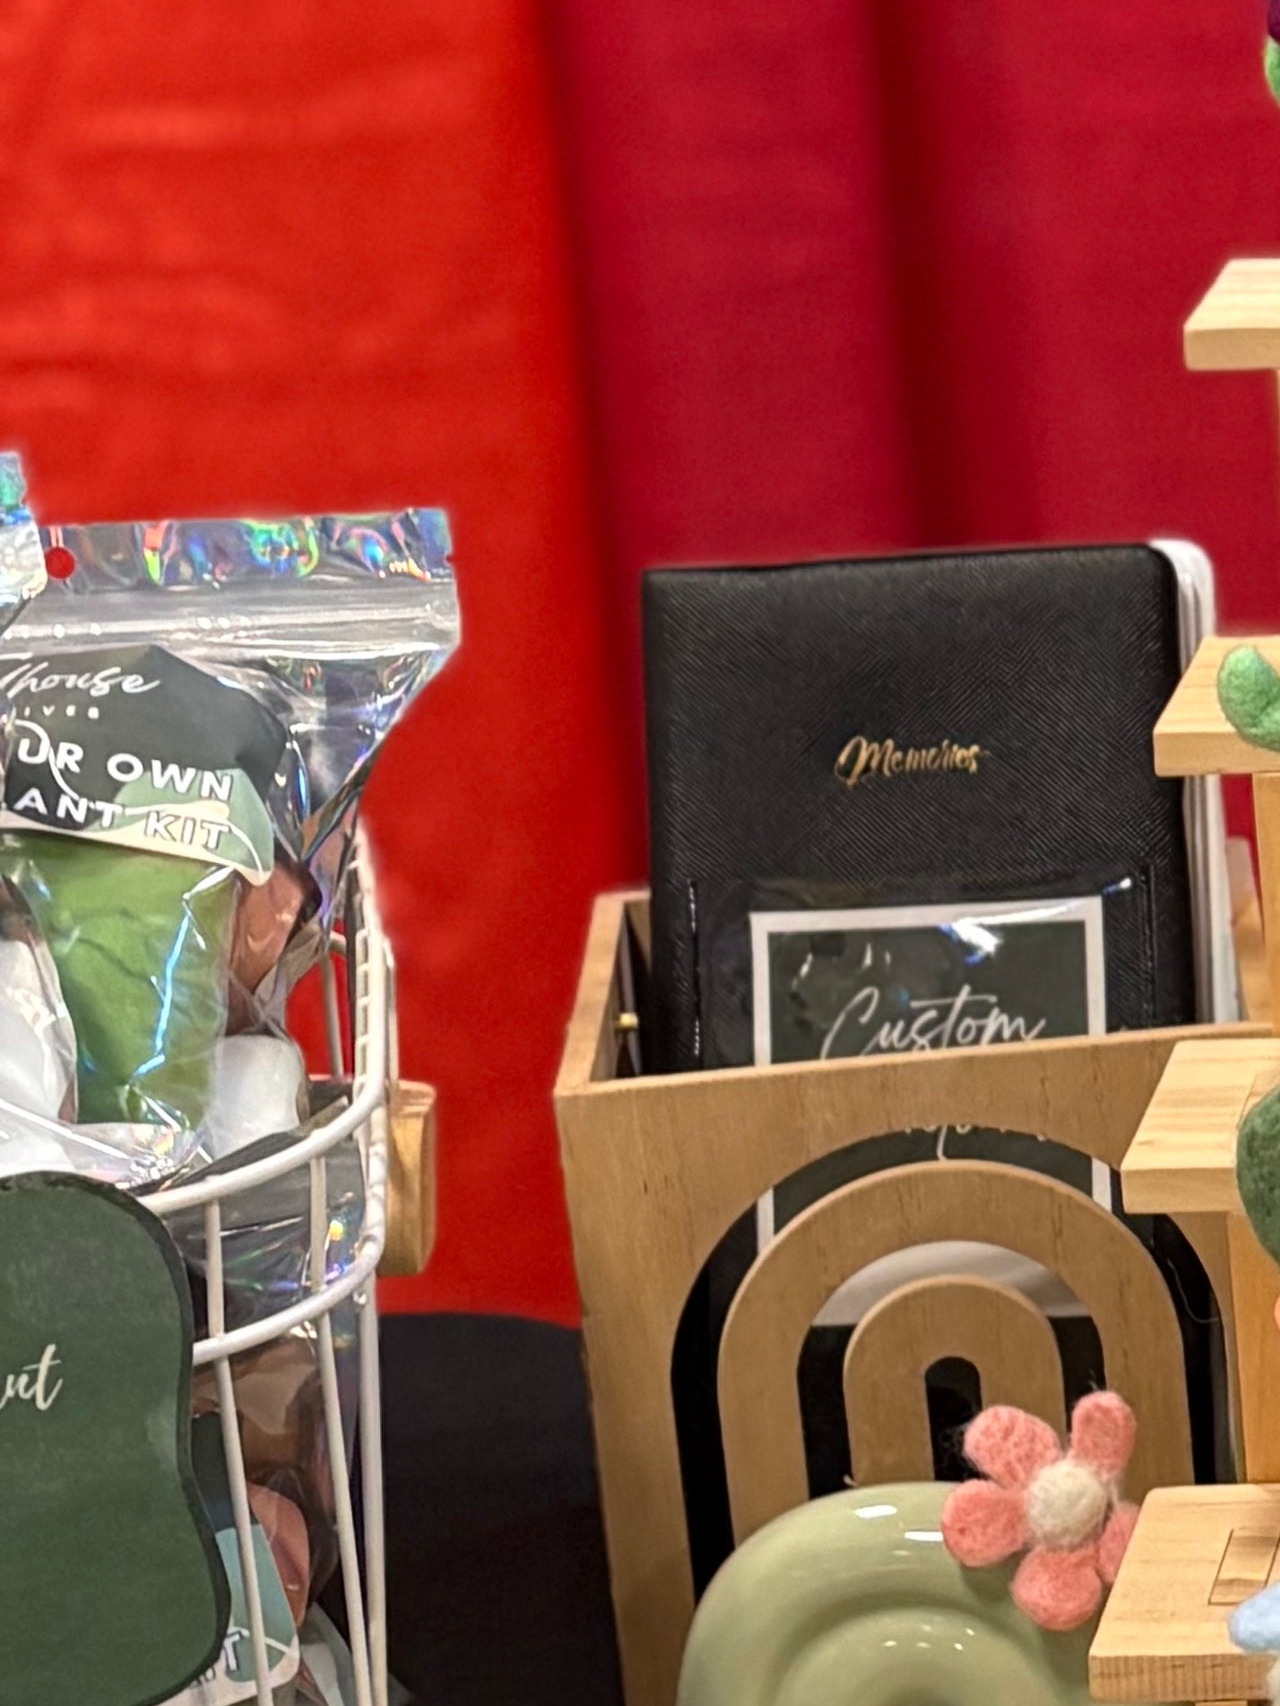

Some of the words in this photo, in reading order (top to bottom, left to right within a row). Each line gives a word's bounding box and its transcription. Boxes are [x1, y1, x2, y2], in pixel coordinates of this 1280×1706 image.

[106, 753, 233, 801] OWN
[834, 736, 980, 789] Memories
[145, 810, 230, 850] KIT
[820, 984, 1046, 1061] Custom
